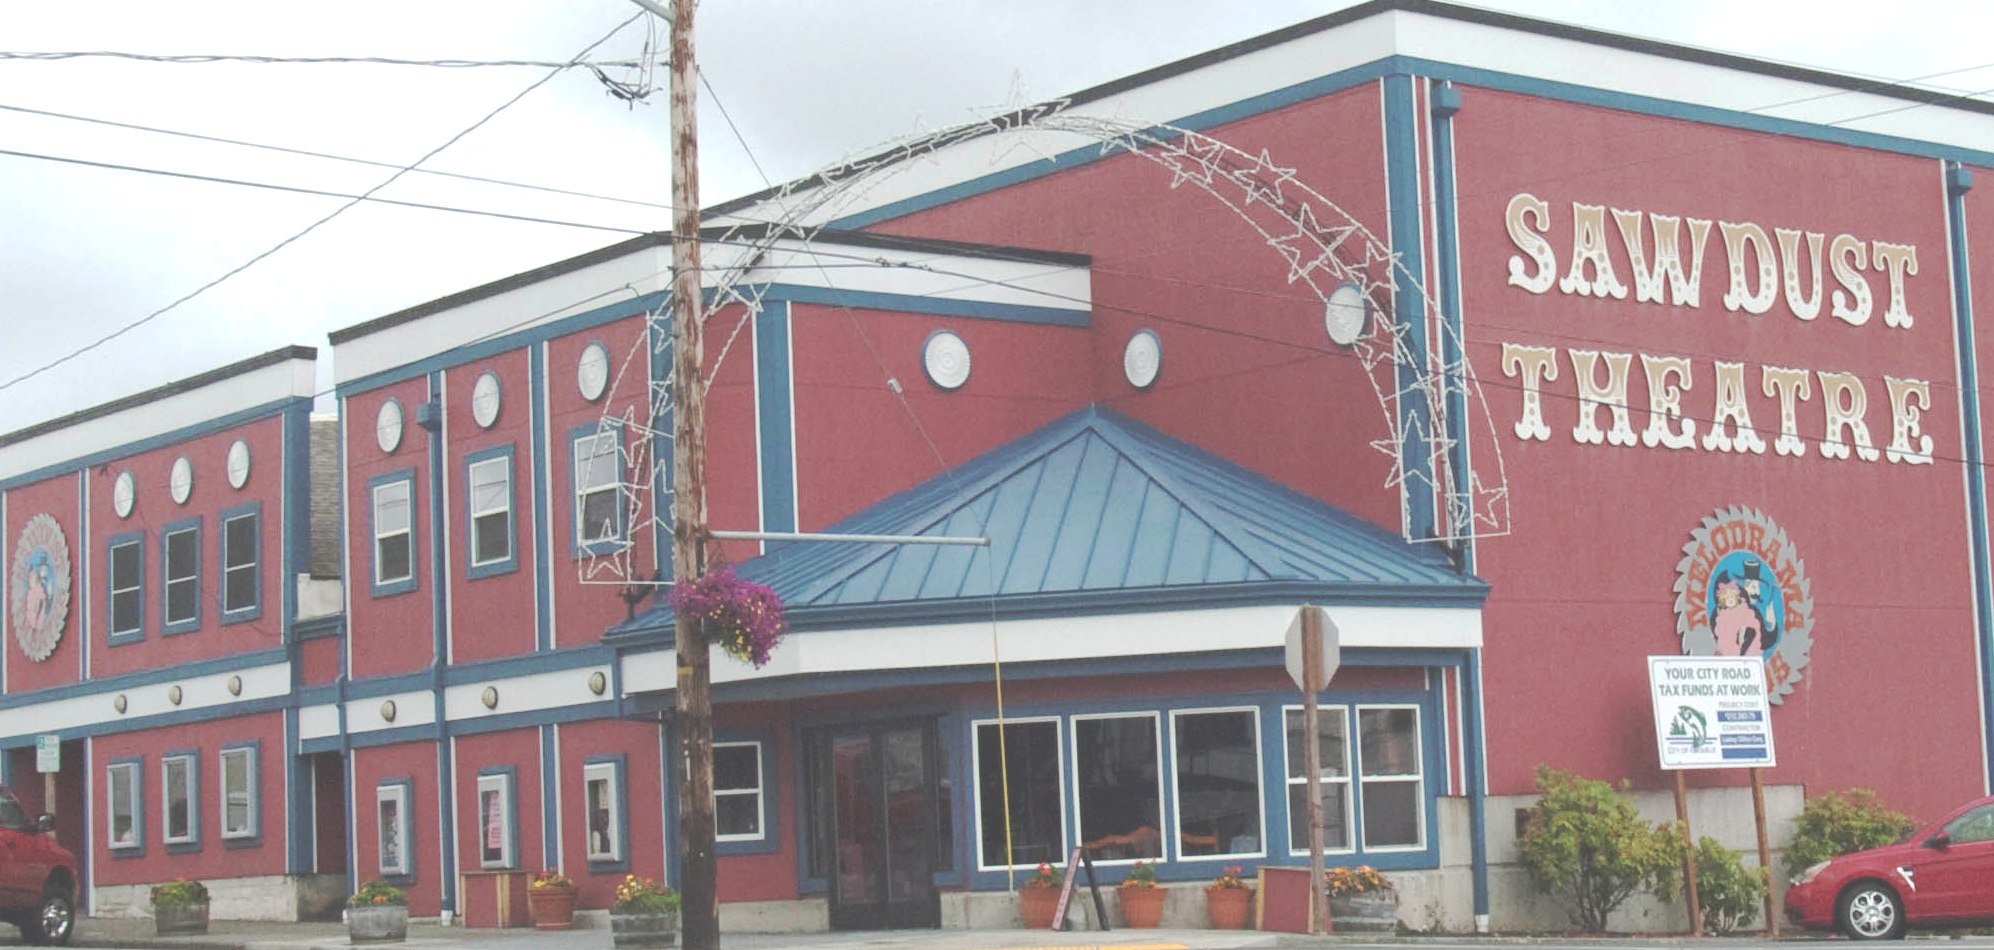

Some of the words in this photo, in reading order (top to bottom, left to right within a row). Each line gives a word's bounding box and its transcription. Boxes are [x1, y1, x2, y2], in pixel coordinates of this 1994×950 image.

[1505, 193, 1919, 330] SAWDUST
[1501, 342, 1934, 465] THEATRE
[1684, 520, 1805, 632] MELODRAMA
[1658, 684, 1680, 697] TAX
[1681, 684, 1715, 697] FUNDS
[1716, 684, 1729, 697] AT
[1730, 683, 1761, 696] WORK
[1664, 667, 1694, 680] YOUR
[1696, 667, 1719, 680] CITY
[1721, 667, 1752, 680] ROAD
